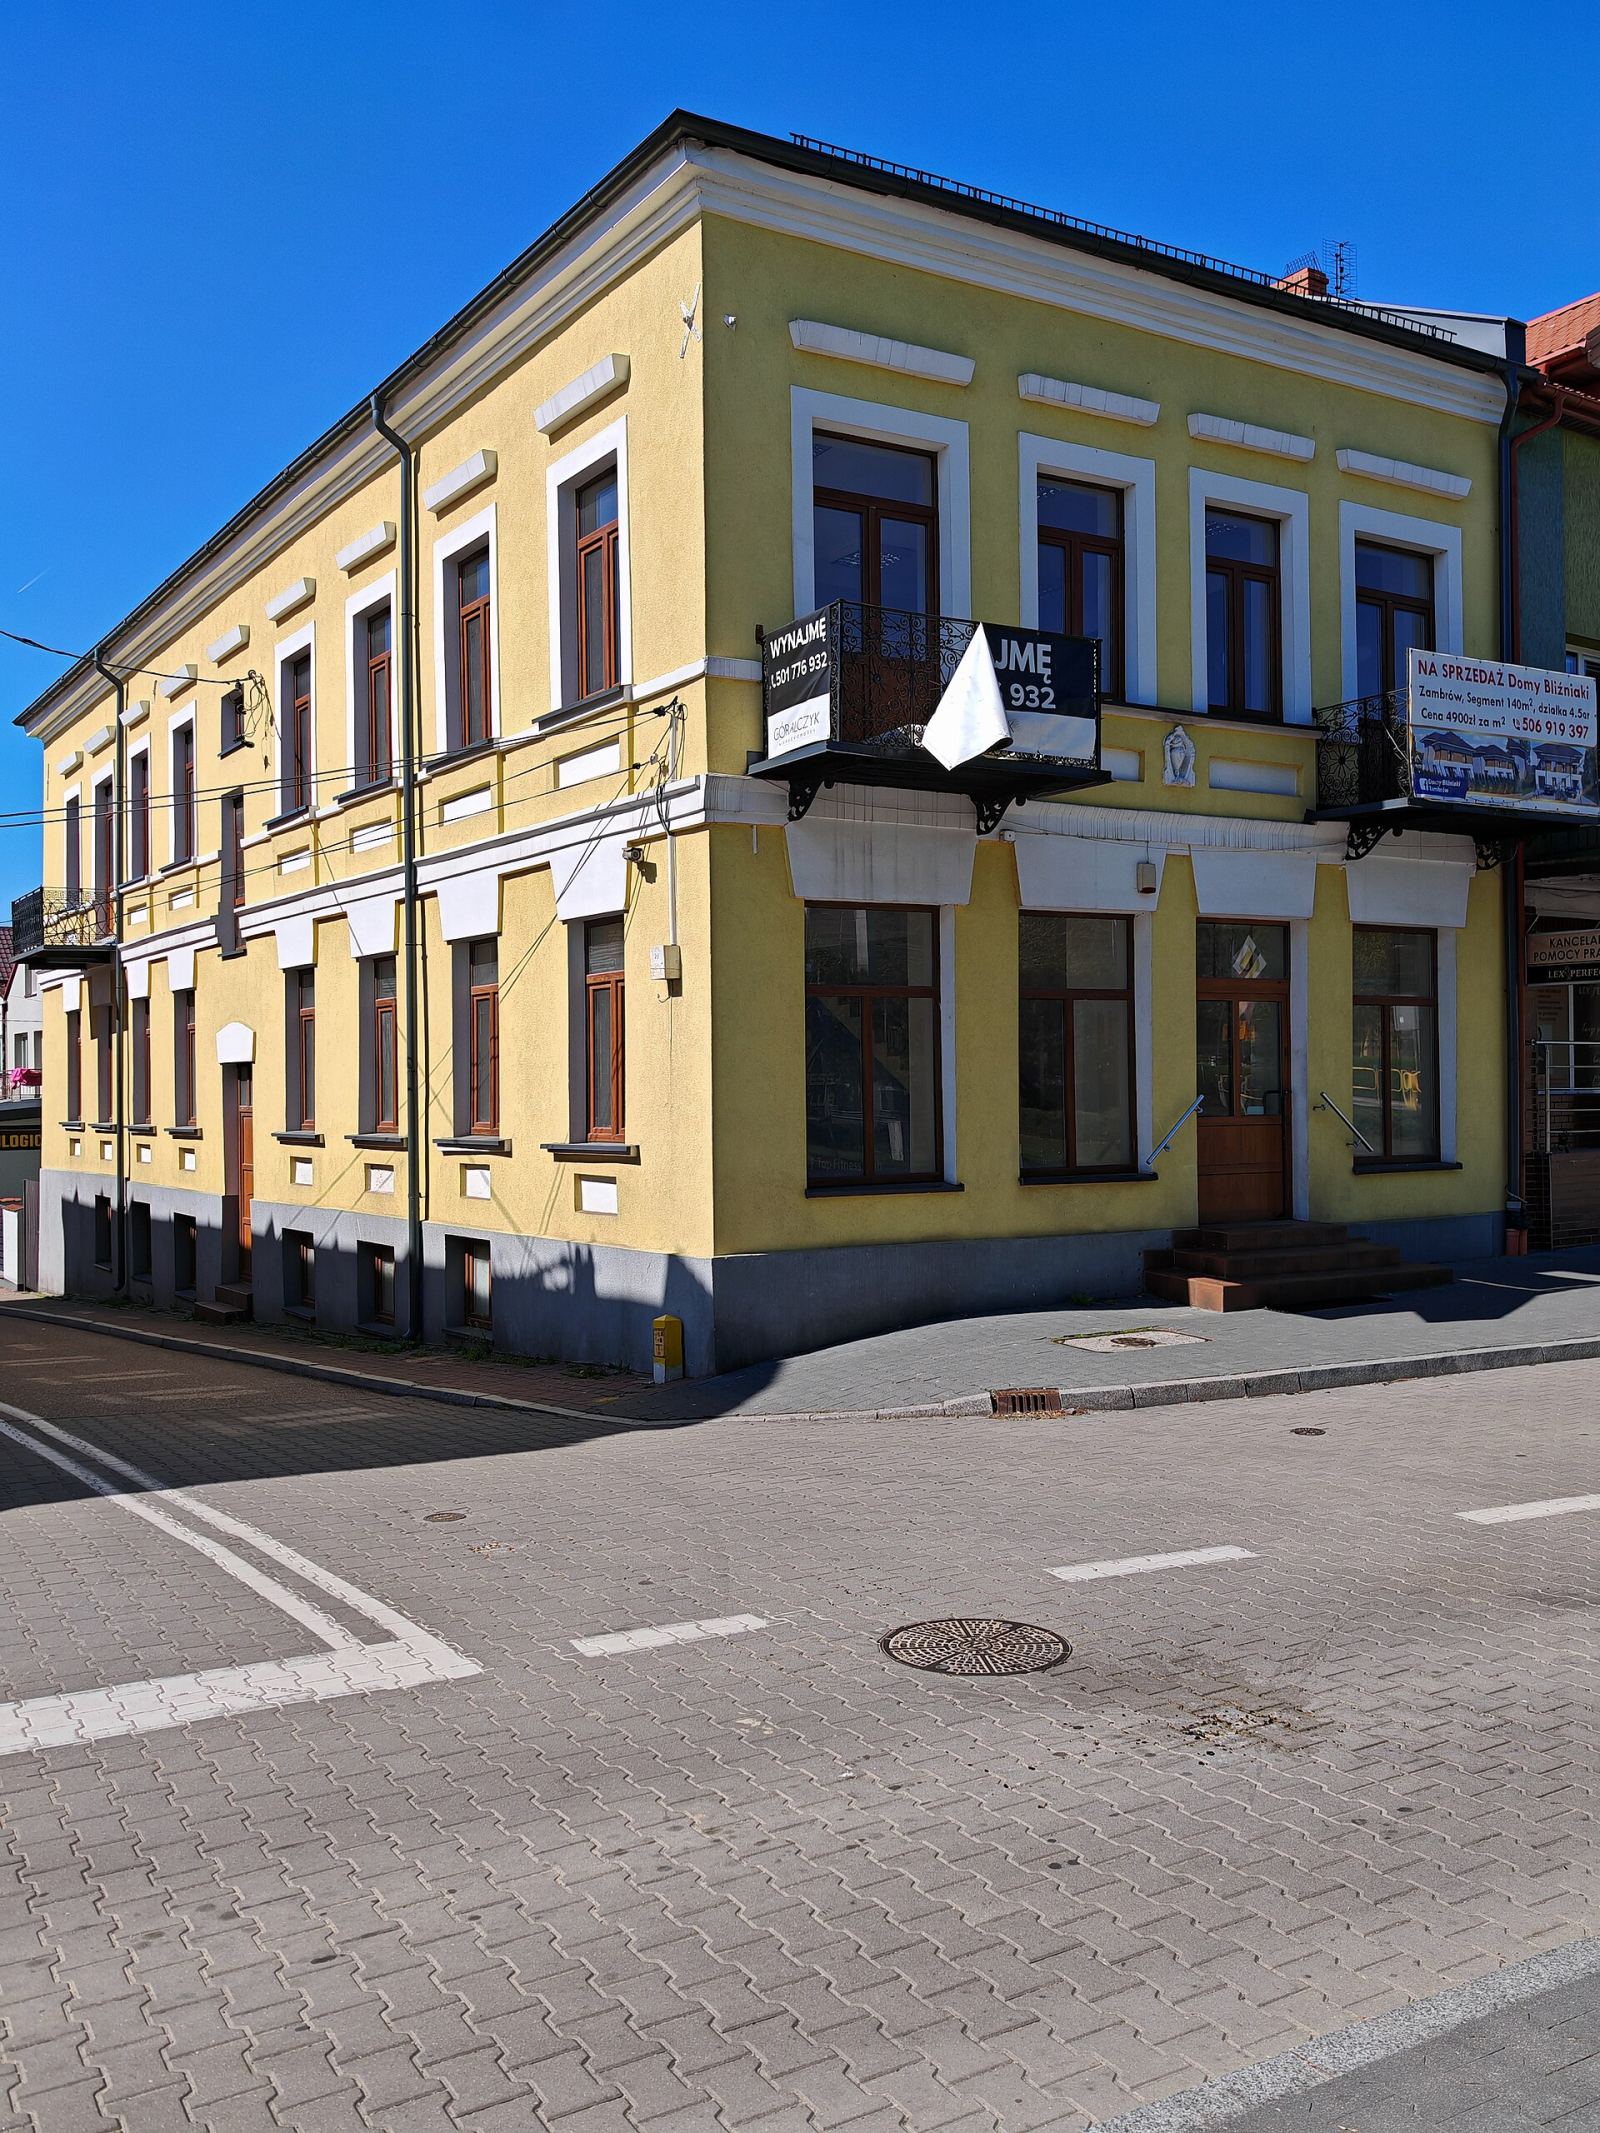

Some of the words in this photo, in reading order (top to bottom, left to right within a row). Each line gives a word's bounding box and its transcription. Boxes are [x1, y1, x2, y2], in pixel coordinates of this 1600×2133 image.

[770, 617, 826, 659] WYNAJMĘ
[776, 667, 790, 686] 501
[791, 660, 807, 680] 776
[809, 651, 827, 672] 932
[994, 638, 1051, 685] JMĘ
[1010, 683, 1056, 709] 932
[1418, 660, 1438, 676] NA
[1442, 663, 1504, 687] SPRZEDAŻ
[1508, 673, 1540, 695] Domy
[1544, 679, 1589, 700] Bliźniaki
[1419, 685, 1464, 704] Zambrów,
[1467, 692, 1504, 707] Segment
[1569, 707, 1590, 719] 4.5ar
[774, 711, 819, 740] GÓRALCZYK
[1421, 707, 1443, 720] Cena
[1479, 718, 1489, 727] za
[1522, 717, 1542, 733] 506
[1545, 720, 1565, 736] 919
[1568, 724, 1589, 739] 397
[1533, 949, 1580, 962] POMOCY
[1548, 970, 1565, 979] LEX
[0, 1134, 41, 1147] LOGIC
